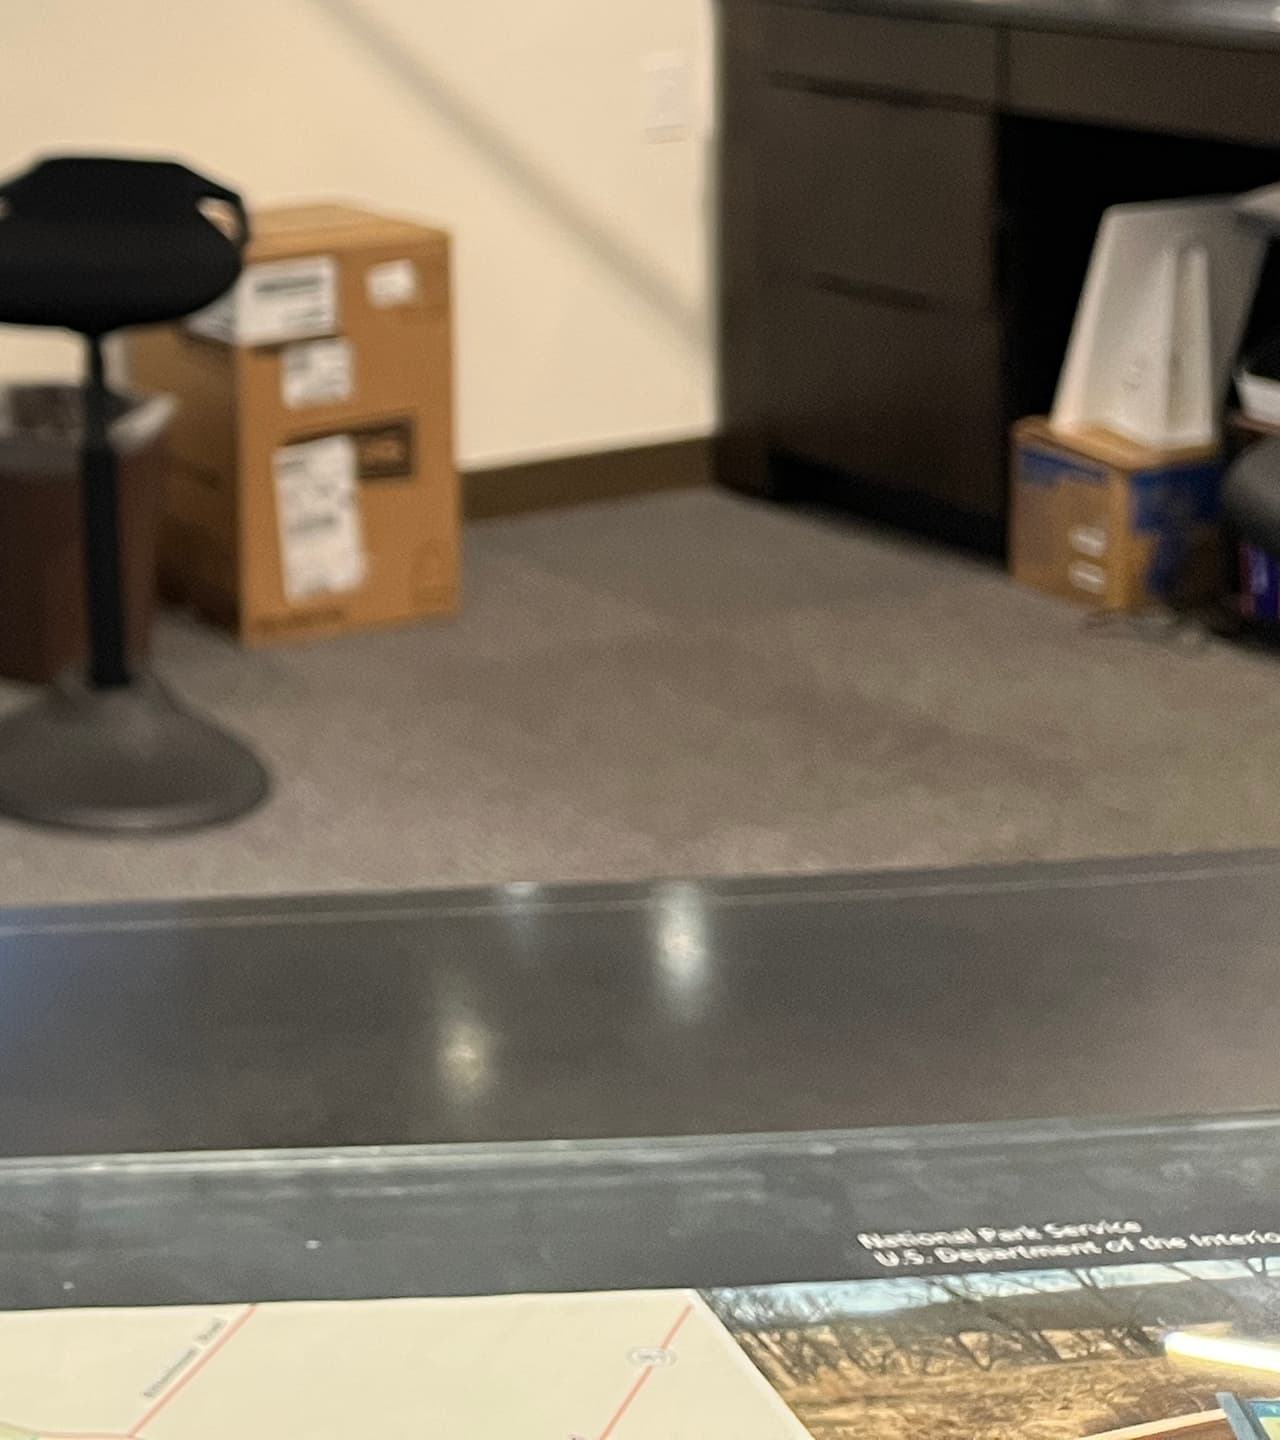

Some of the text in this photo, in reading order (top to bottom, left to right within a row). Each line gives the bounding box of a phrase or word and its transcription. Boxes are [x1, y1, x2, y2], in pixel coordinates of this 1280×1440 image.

[857, 1220, 1142, 1249] National Park Service
[873, 1248, 934, 1266] U.S.
[934, 1240, 1102, 1264] Department
[1105, 1235, 1135, 1253] of
[1140, 1235, 1188, 1250] the
